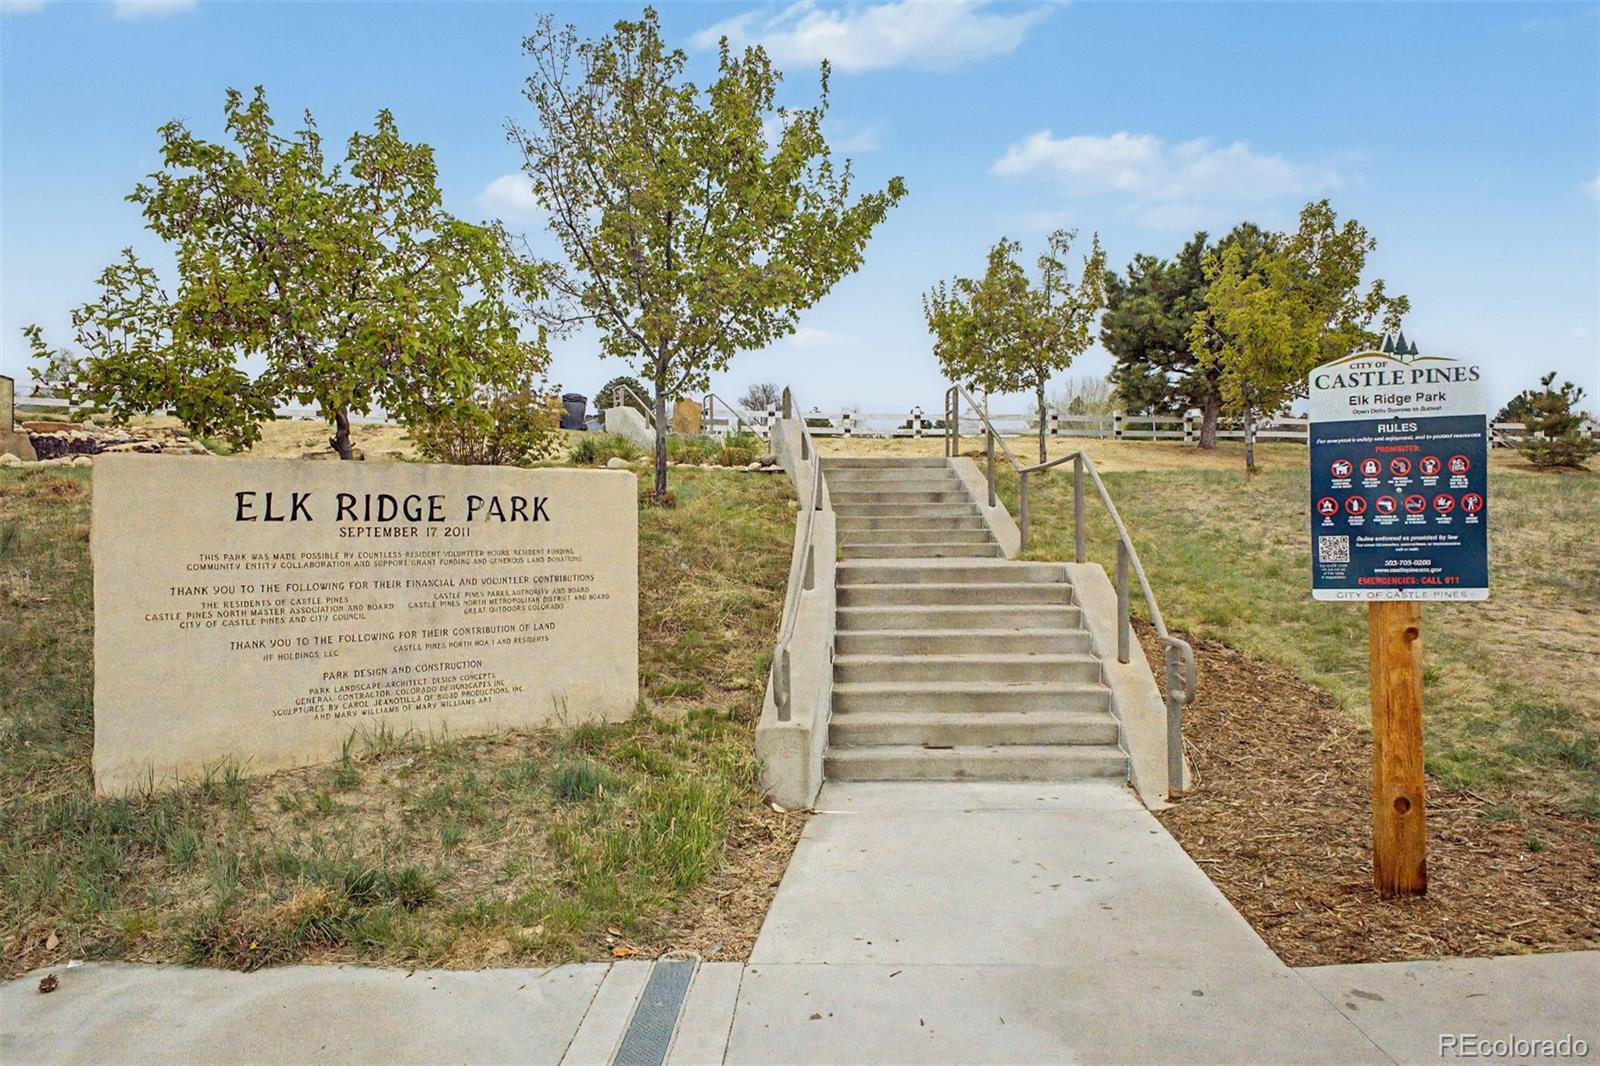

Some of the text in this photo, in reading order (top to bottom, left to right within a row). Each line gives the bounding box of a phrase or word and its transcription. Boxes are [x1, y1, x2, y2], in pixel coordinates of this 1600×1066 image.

[1350, 362, 1372, 370] CITY
[1315, 366, 1480, 390] CASTLE PINES
[1350, 392, 1446, 406] Elk Ridge Park
[1378, 423, 1417, 433] RULES
[235, 491, 551, 523] ELK RIDGE PARK
[339, 526, 418, 538] SEPTEMBER
[444, 526, 471, 538] 2011
[200, 554, 220, 562] THIS
[224, 553, 247, 561] PARK
[252, 553, 269, 561] WAS
[273, 552, 297, 560] MADE
[301, 552, 339, 560] POSSIBLE
[358, 551, 402, 560] COUNTLESS
[187, 562, 241, 571] COMMUNITY
[245, 562, 277, 570] ENTITY
[280, 560, 350, 569] COLLABORATION
[170, 574, 595, 597] THANK YOU TO THE FOLLOWING FOR THEIR FINANCIAL AND VOLUNTEER CONTRIBUTIONS
[1386, 591, 1428, 599] CASTLE
[223, 600, 271, 609] RESIDENTS
[326, 596, 349, 604] PINES
[145, 613, 182, 622] CASTLE
[187, 611, 213, 619] PINES
[218, 610, 247, 618] NORTH
[250, 608, 285, 616] MASTER
[289, 605, 344, 614] ASSOCIATION
[367, 603, 394, 611] BOARD
[179, 620, 201, 629] CITY
[206, 620, 218, 628] OF
[222, 618, 257, 627] CASTLE
[260, 617, 285, 625] PINES
[289, 616, 306, 624] AND
[230, 623, 556, 650] THANK YOU TO THE FOLLOWING FOR THEIR CONTRIBUTION OF LAND
[323, 660, 482, 680] PARK DESIGN AND CONSTRUCTION
[334, 682, 381, 693] LANDSCAPE
[338, 690, 390, 700] CONTRACTOR
[273, 704, 324, 717] SCULPTURES
[343, 701, 369, 710] CAROL
